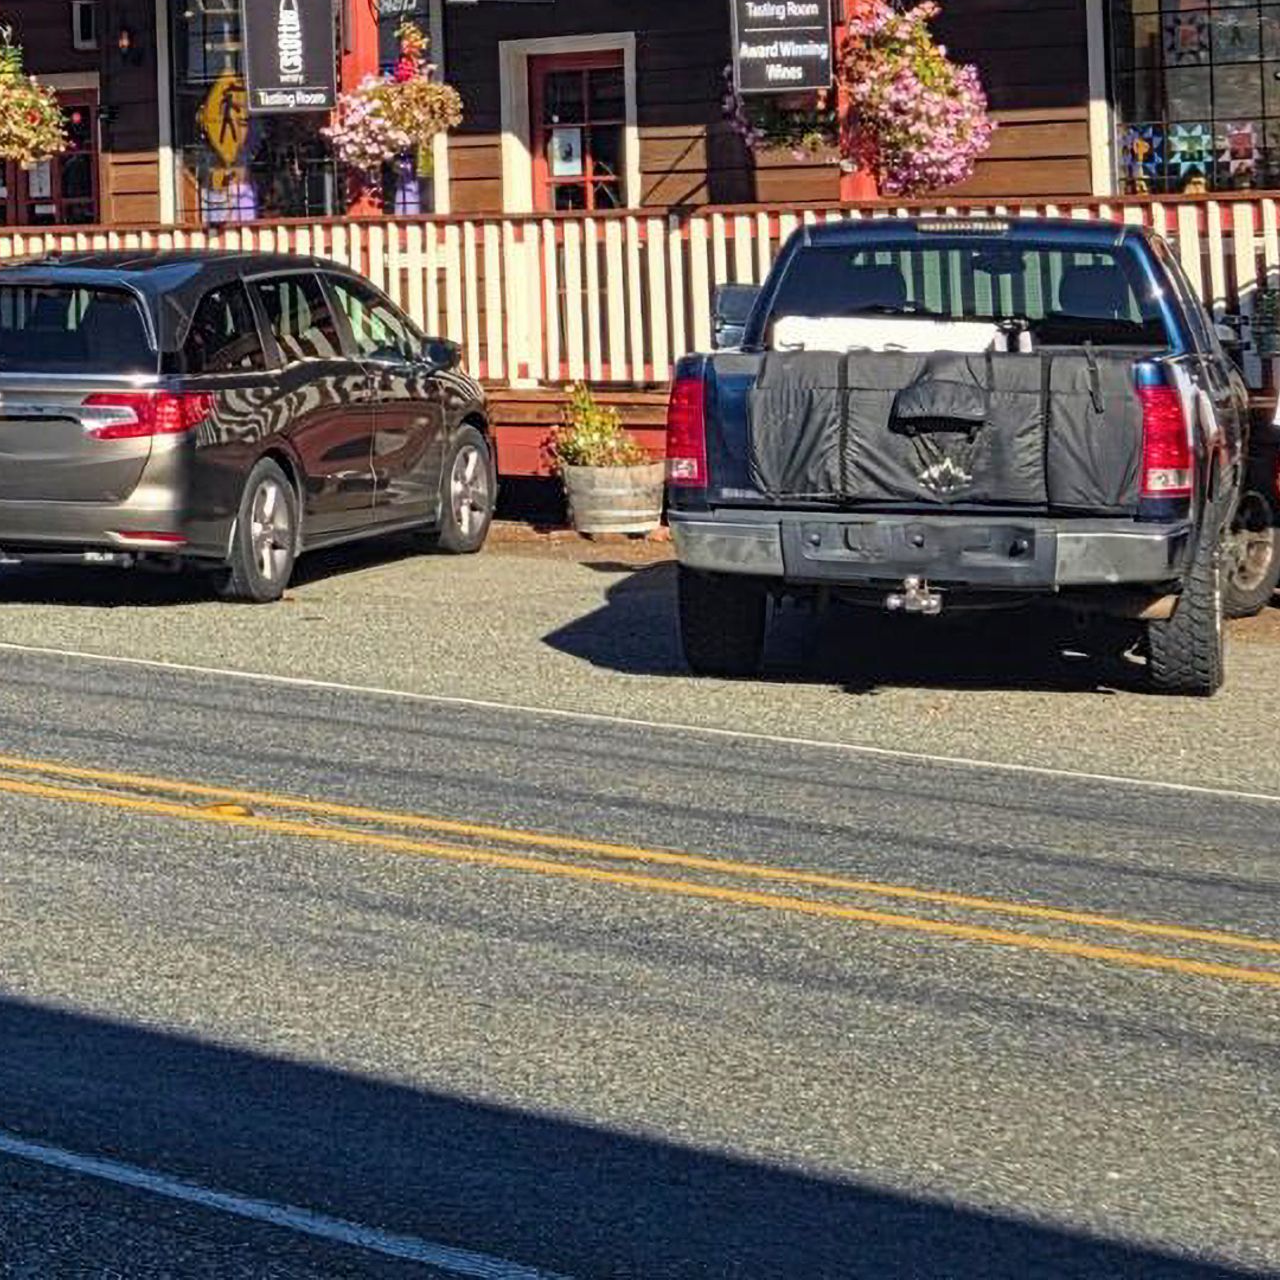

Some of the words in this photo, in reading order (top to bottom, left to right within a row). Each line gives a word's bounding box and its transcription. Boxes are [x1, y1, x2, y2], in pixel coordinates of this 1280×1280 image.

[745, 2, 786, 19] Tasting
[787, 1, 819, 16] Room
[741, 41, 778, 58] Award
[779, 41, 828, 60] Winning
[765, 64, 803, 80] Wines
[259, 92, 294, 107] Tasting
[295, 91, 326, 104] Room
